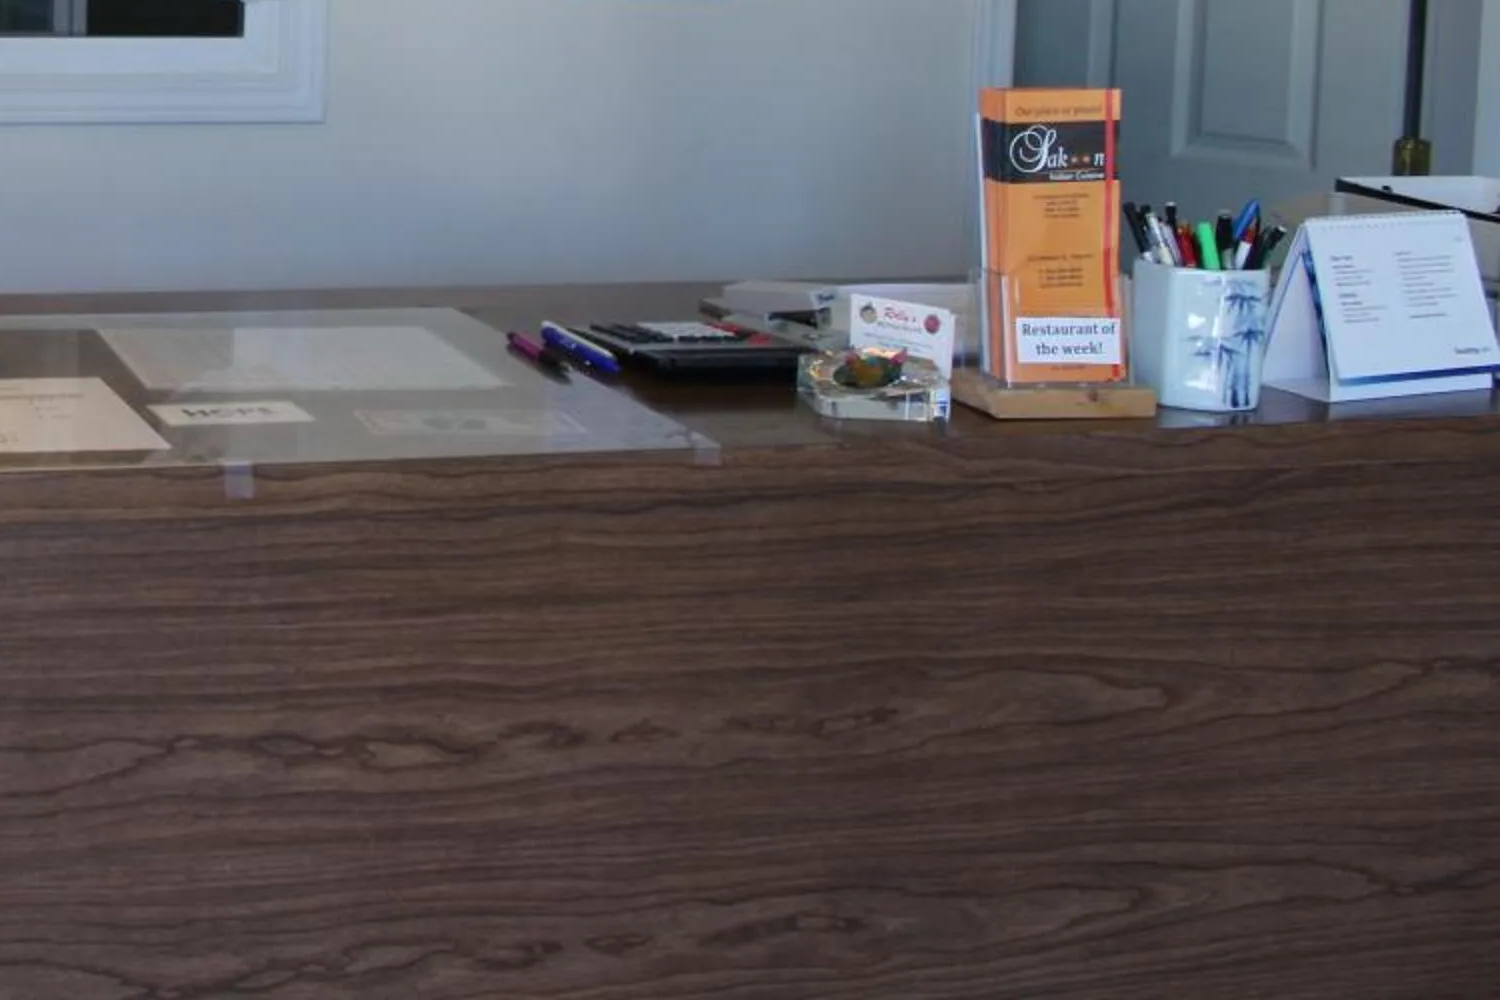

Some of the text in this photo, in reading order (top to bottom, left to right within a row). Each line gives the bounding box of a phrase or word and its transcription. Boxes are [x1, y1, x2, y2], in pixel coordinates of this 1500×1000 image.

[1021, 322, 1116, 336] Restaurant of
[1035, 340, 1103, 356] the week!
